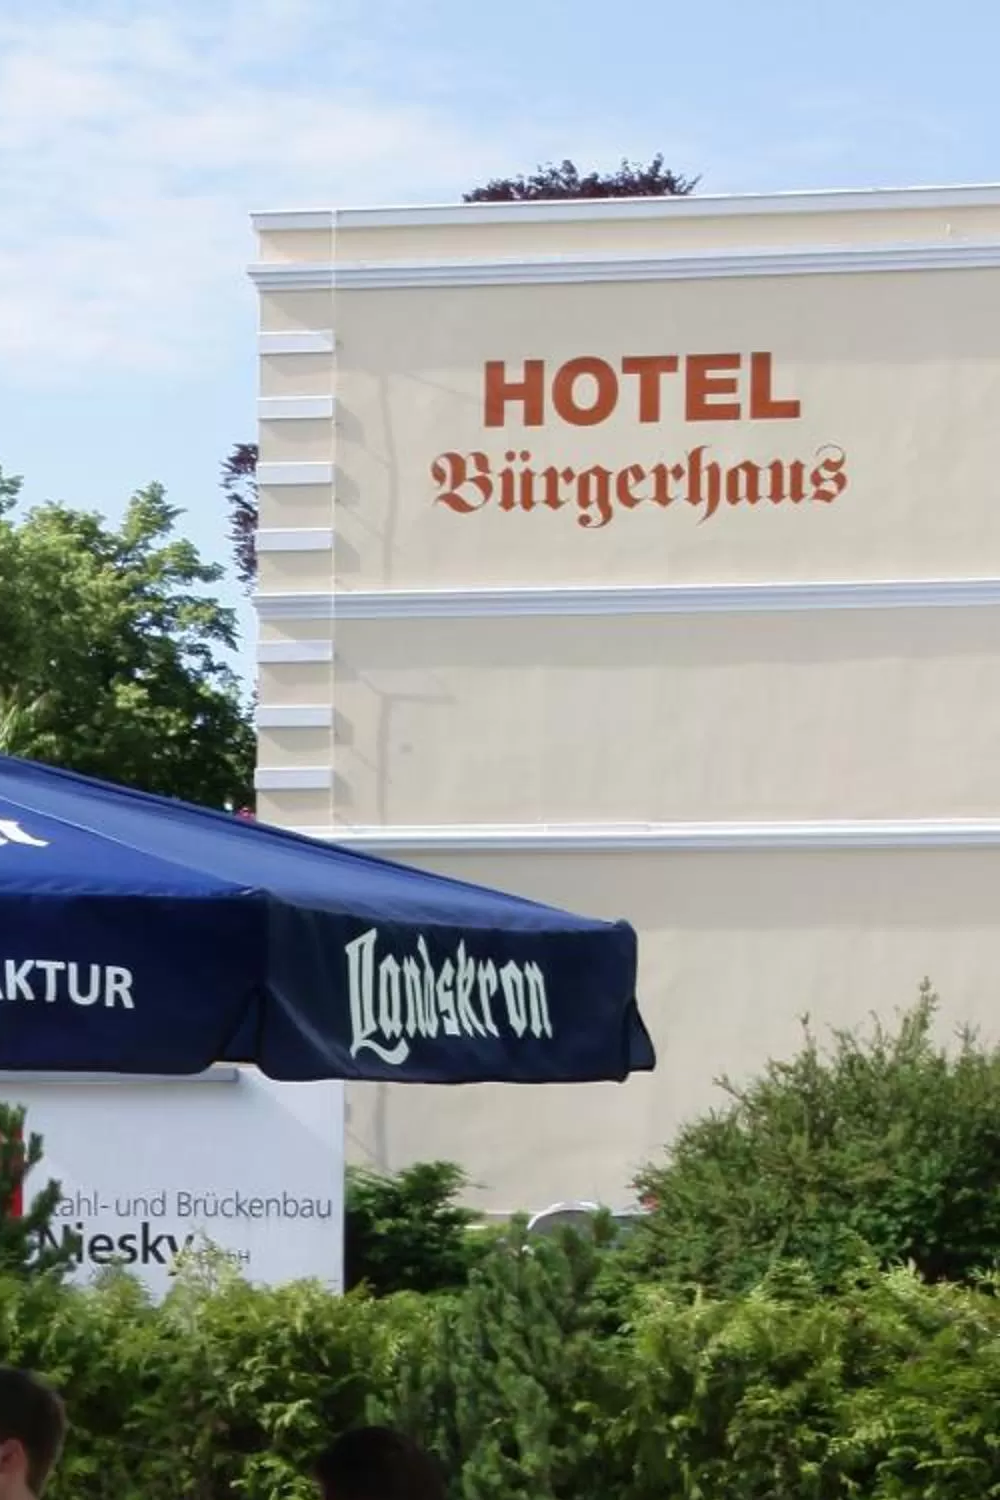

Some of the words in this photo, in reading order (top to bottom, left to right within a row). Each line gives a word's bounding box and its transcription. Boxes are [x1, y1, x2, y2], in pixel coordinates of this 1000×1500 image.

[484, 352, 801, 427] HOTEL
[431, 444, 847, 529] Bürgerhaus
[345, 928, 553, 1065] Landskron
[50, 1190, 108, 1218] ahl-
[115, 1192, 167, 1217] und
[177, 1191, 332, 1219] Brückenbau
